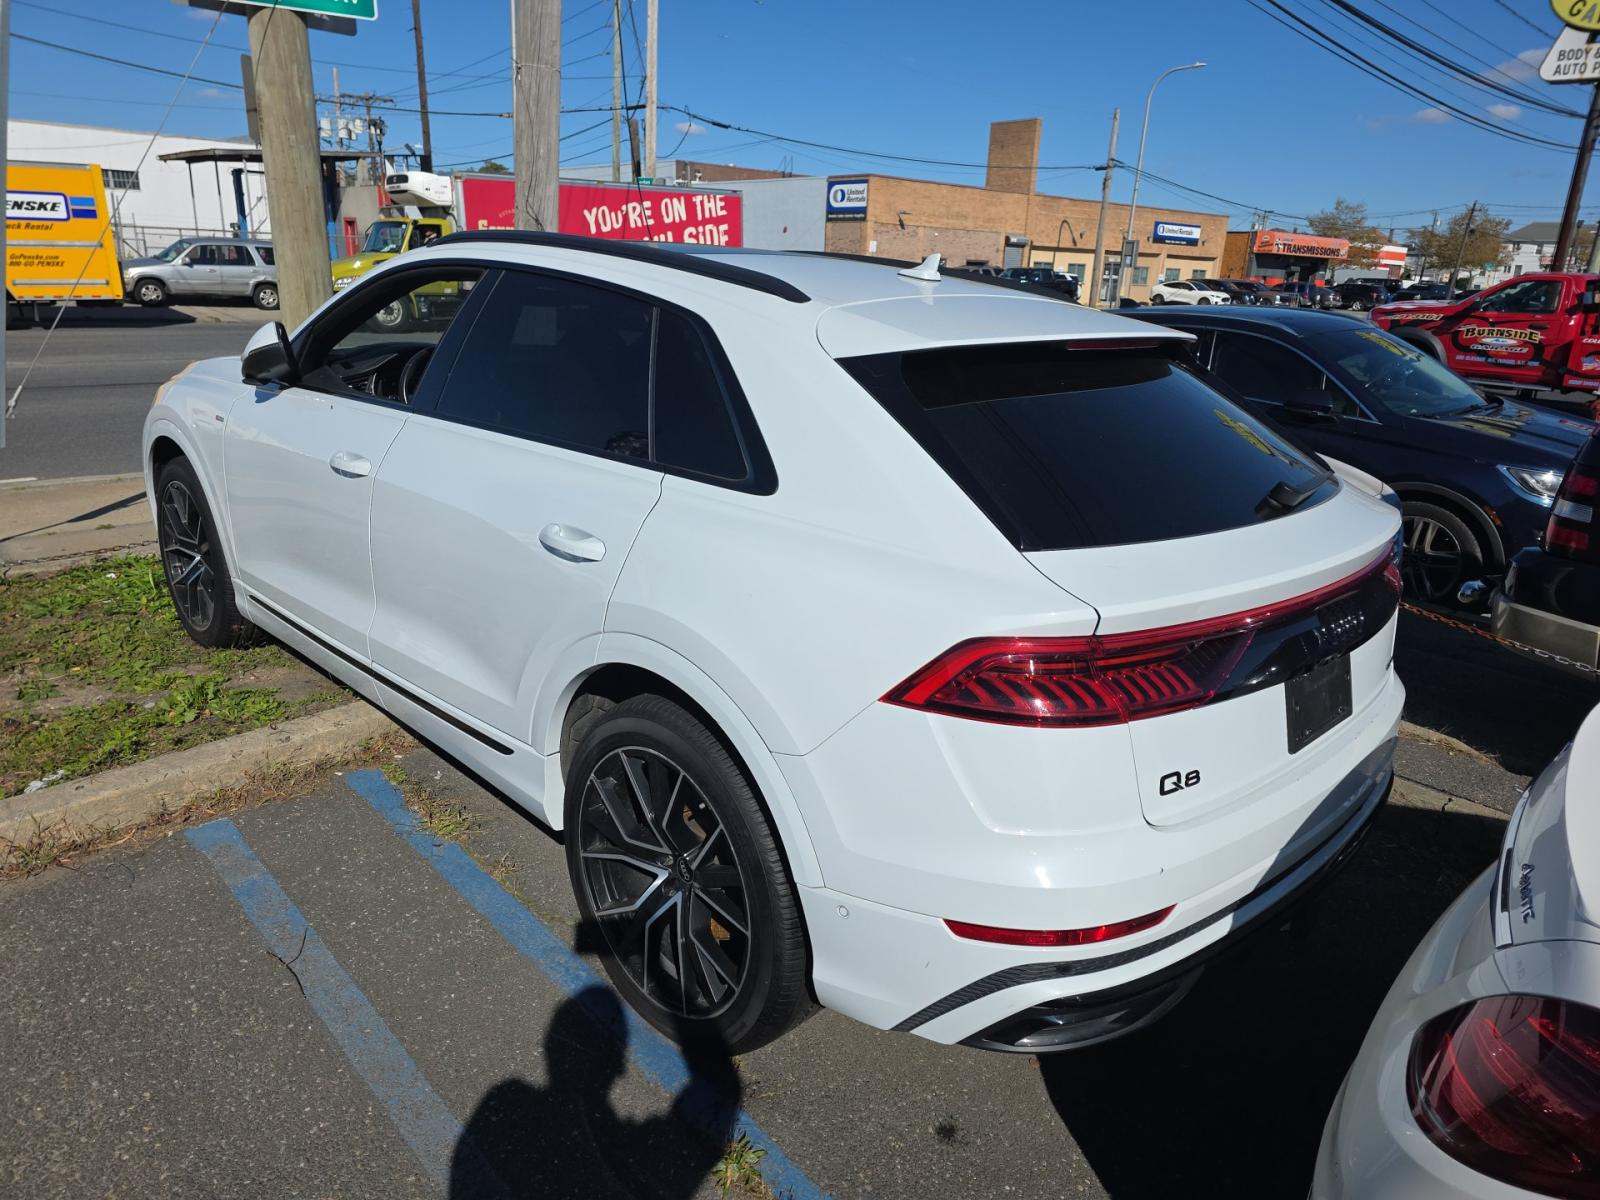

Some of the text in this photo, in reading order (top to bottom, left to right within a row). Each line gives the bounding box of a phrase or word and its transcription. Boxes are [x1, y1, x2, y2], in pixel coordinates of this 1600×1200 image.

[1557, 47, 1592, 61] BODY
[1553, 62, 1587, 76] AUTO
[846, 188, 865, 196] United
[6, 200, 61, 211] ENSKE
[660, 196, 687, 224] ON
[692, 194, 728, 221] THE
[25, 222, 53, 231] Rental
[1281, 242, 1340, 257] TRANSMISSIONS
[1464, 326, 1540, 343] BURNSIDE
[1159, 769, 1201, 797] Q8
